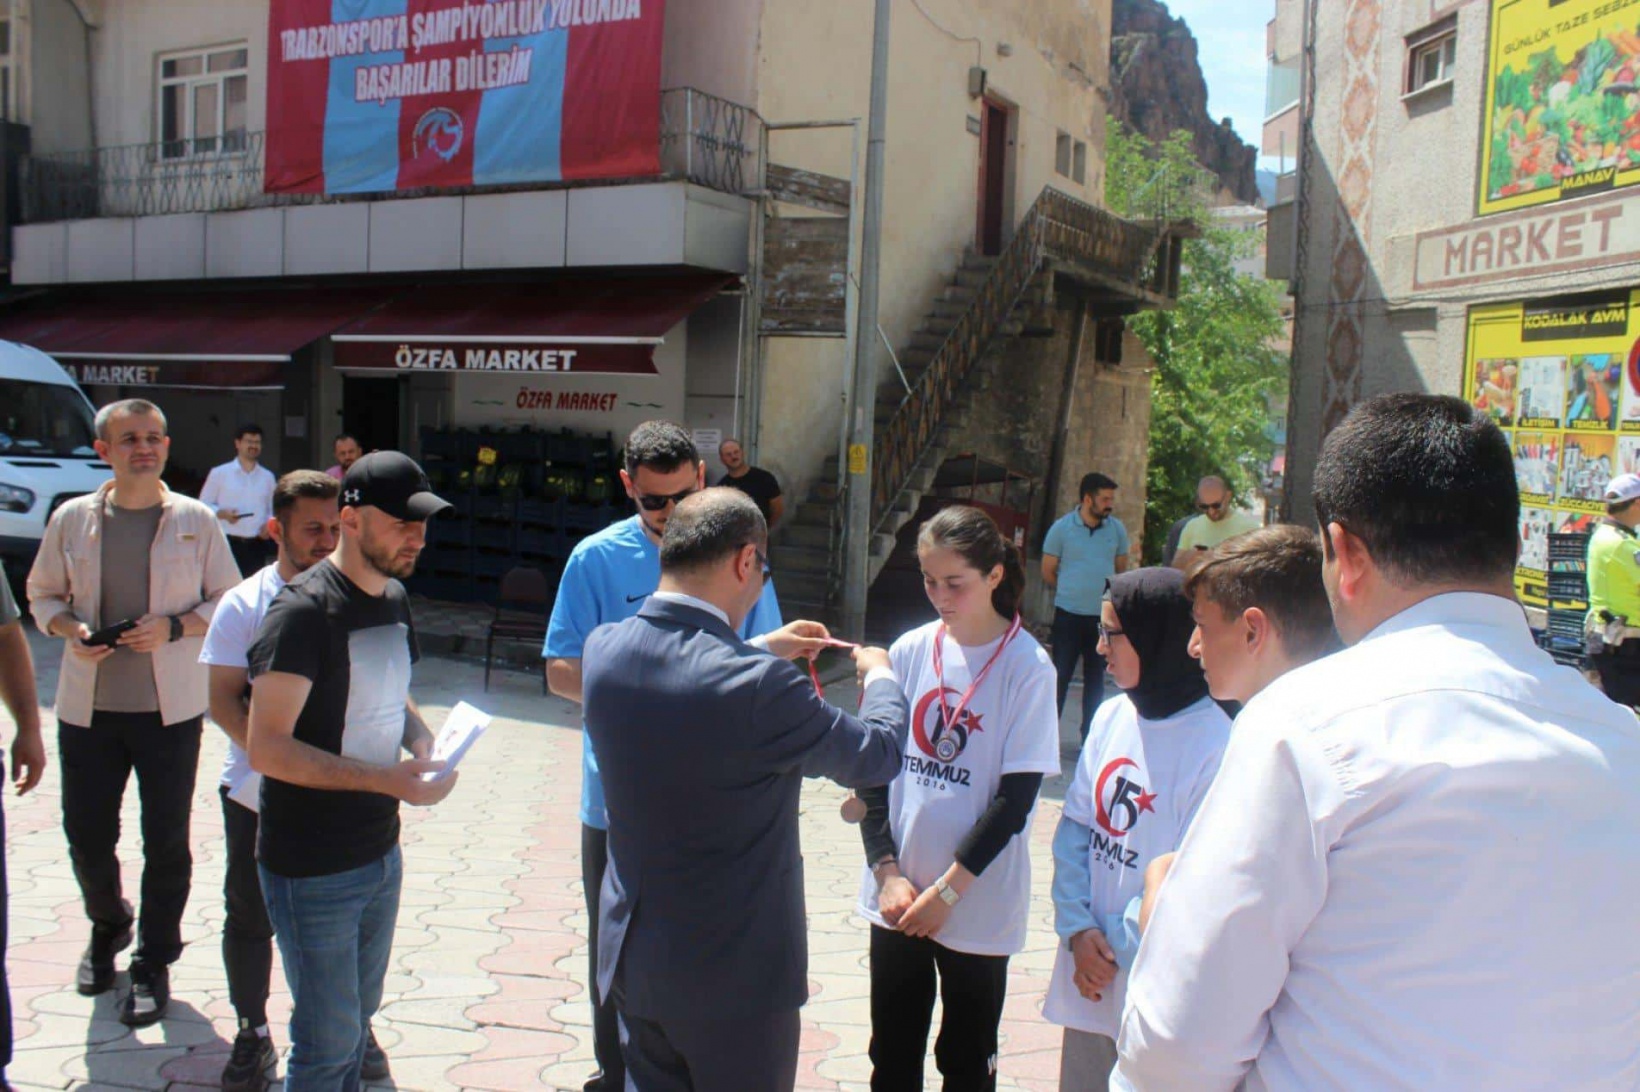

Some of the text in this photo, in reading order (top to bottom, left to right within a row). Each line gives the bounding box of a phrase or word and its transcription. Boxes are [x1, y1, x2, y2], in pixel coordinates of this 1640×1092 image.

[281, 0, 641, 62] TRABZONSPOR'A ŞAMPİYONLUK YOLUNDA
[1503, 0, 1640, 55] GÜNLÜK TAZE SEBZ
[356, 45, 532, 106] BAŞARILAR DİLERİM
[1561, 167, 1614, 190] MANAV
[1444, 204, 1623, 276] MARKET
[1591, 308, 1626, 324] AVM
[395, 344, 577, 370] ÖZFA MARKET
[83, 366, 159, 384] MARKET
[516, 386, 618, 412] ÖZFA MARKET
[904, 755, 971, 787] TEMMUZ
[916, 776, 946, 791] 2016
[1108, 776, 1142, 831] 15
